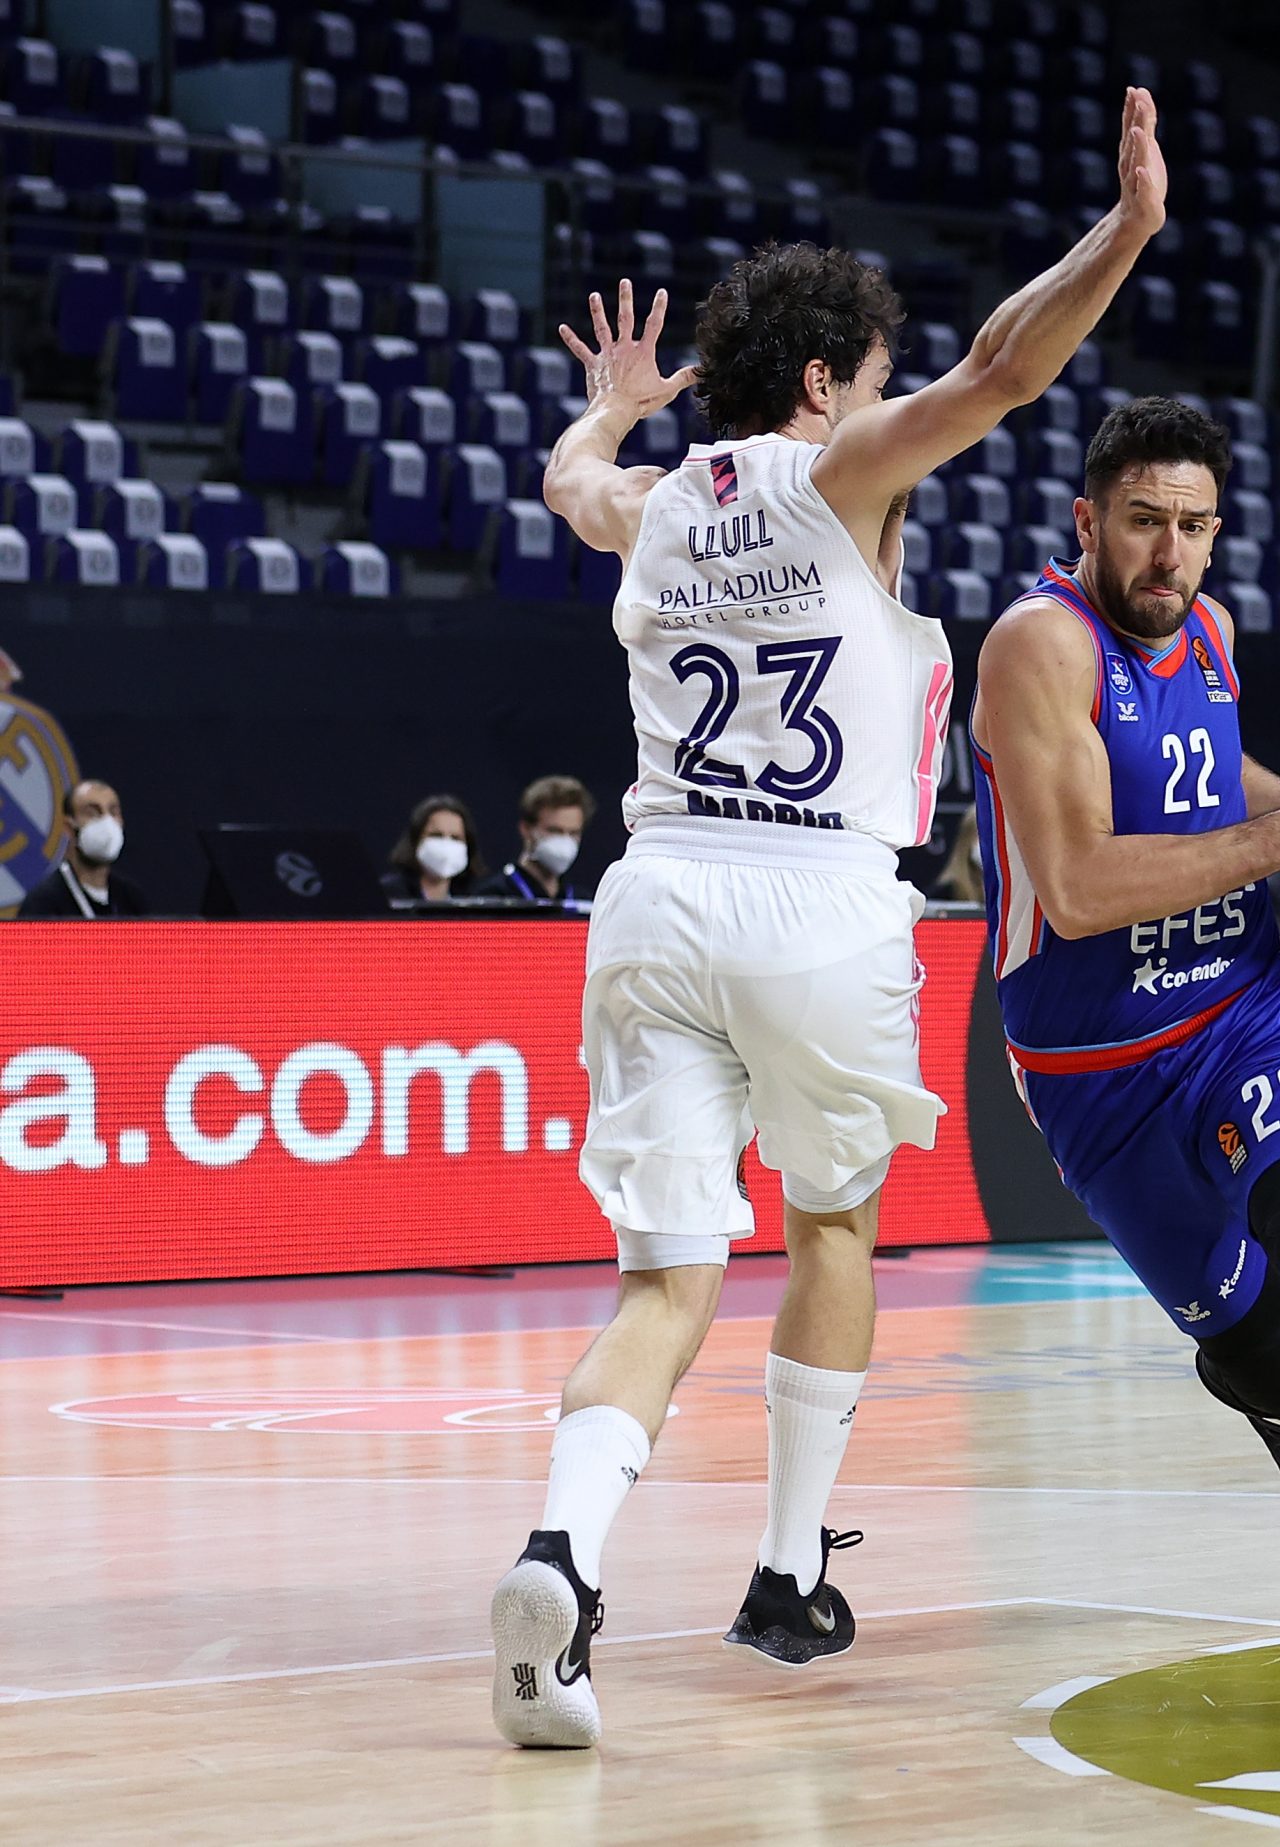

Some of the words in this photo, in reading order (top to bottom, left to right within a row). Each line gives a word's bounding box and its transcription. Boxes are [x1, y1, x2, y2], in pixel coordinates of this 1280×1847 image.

[688, 509, 774, 562] LLULL
[659, 561, 822, 610] PALLADIUM
[662, 611, 728, 629] HOTEL
[745, 597, 827, 620] GROUP
[668, 636, 844, 802] 23
[1162, 727, 1220, 814] 22
[1131, 891, 1246, 954] EFES
[1161, 957, 1236, 989] corendo
[0, 1042, 585, 1172] a.com.
